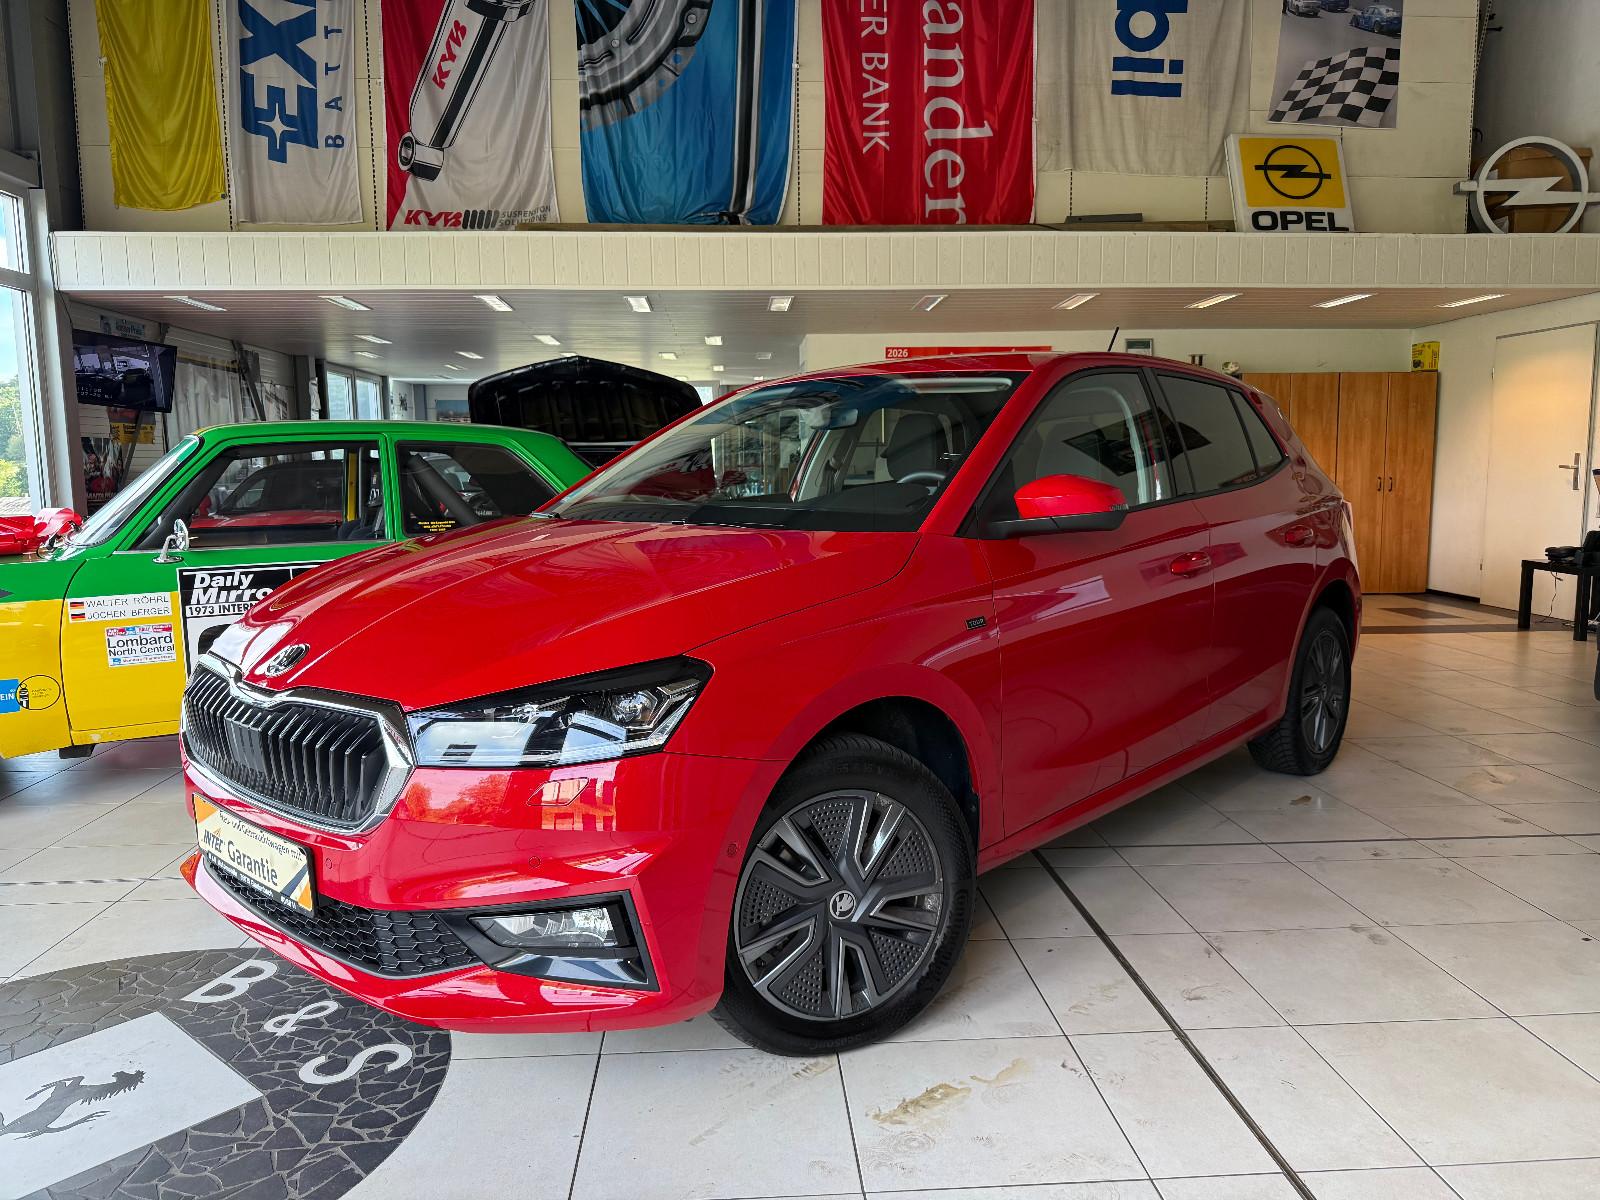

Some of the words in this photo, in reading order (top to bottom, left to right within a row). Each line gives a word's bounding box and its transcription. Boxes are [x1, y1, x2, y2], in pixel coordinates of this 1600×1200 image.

[432, 20, 467, 90] KYB
[1111, 0, 1188, 97] bil
[238, 0, 319, 163] EX
[323, 0, 345, 148] BATT
[861, 53, 890, 154] BANK
[922, 0, 994, 224] ander
[404, 209, 462, 228] KYB
[499, 214, 548, 226] SOLUTIONS
[1252, 211, 1349, 231] OPEL
[887, 349, 909, 357] 2026
[194, 571, 254, 589] Daily
[86, 598, 128, 608] WALTER
[133, 595, 169, 604] RÖHRL
[190, 587, 274, 605] Mirro
[87, 610, 126, 620] JOCHEN
[131, 607, 170, 617] BERGER
[188, 606, 215, 616] 1973
[107, 633, 173, 649] Lombard
[108, 647, 137, 657] North
[139, 644, 175, 654] Central
[227, 840, 278, 887] Garantie
[181, 959, 278, 1003] B
[263, 1000, 339, 1036] &
[298, 1043, 413, 1085] S
